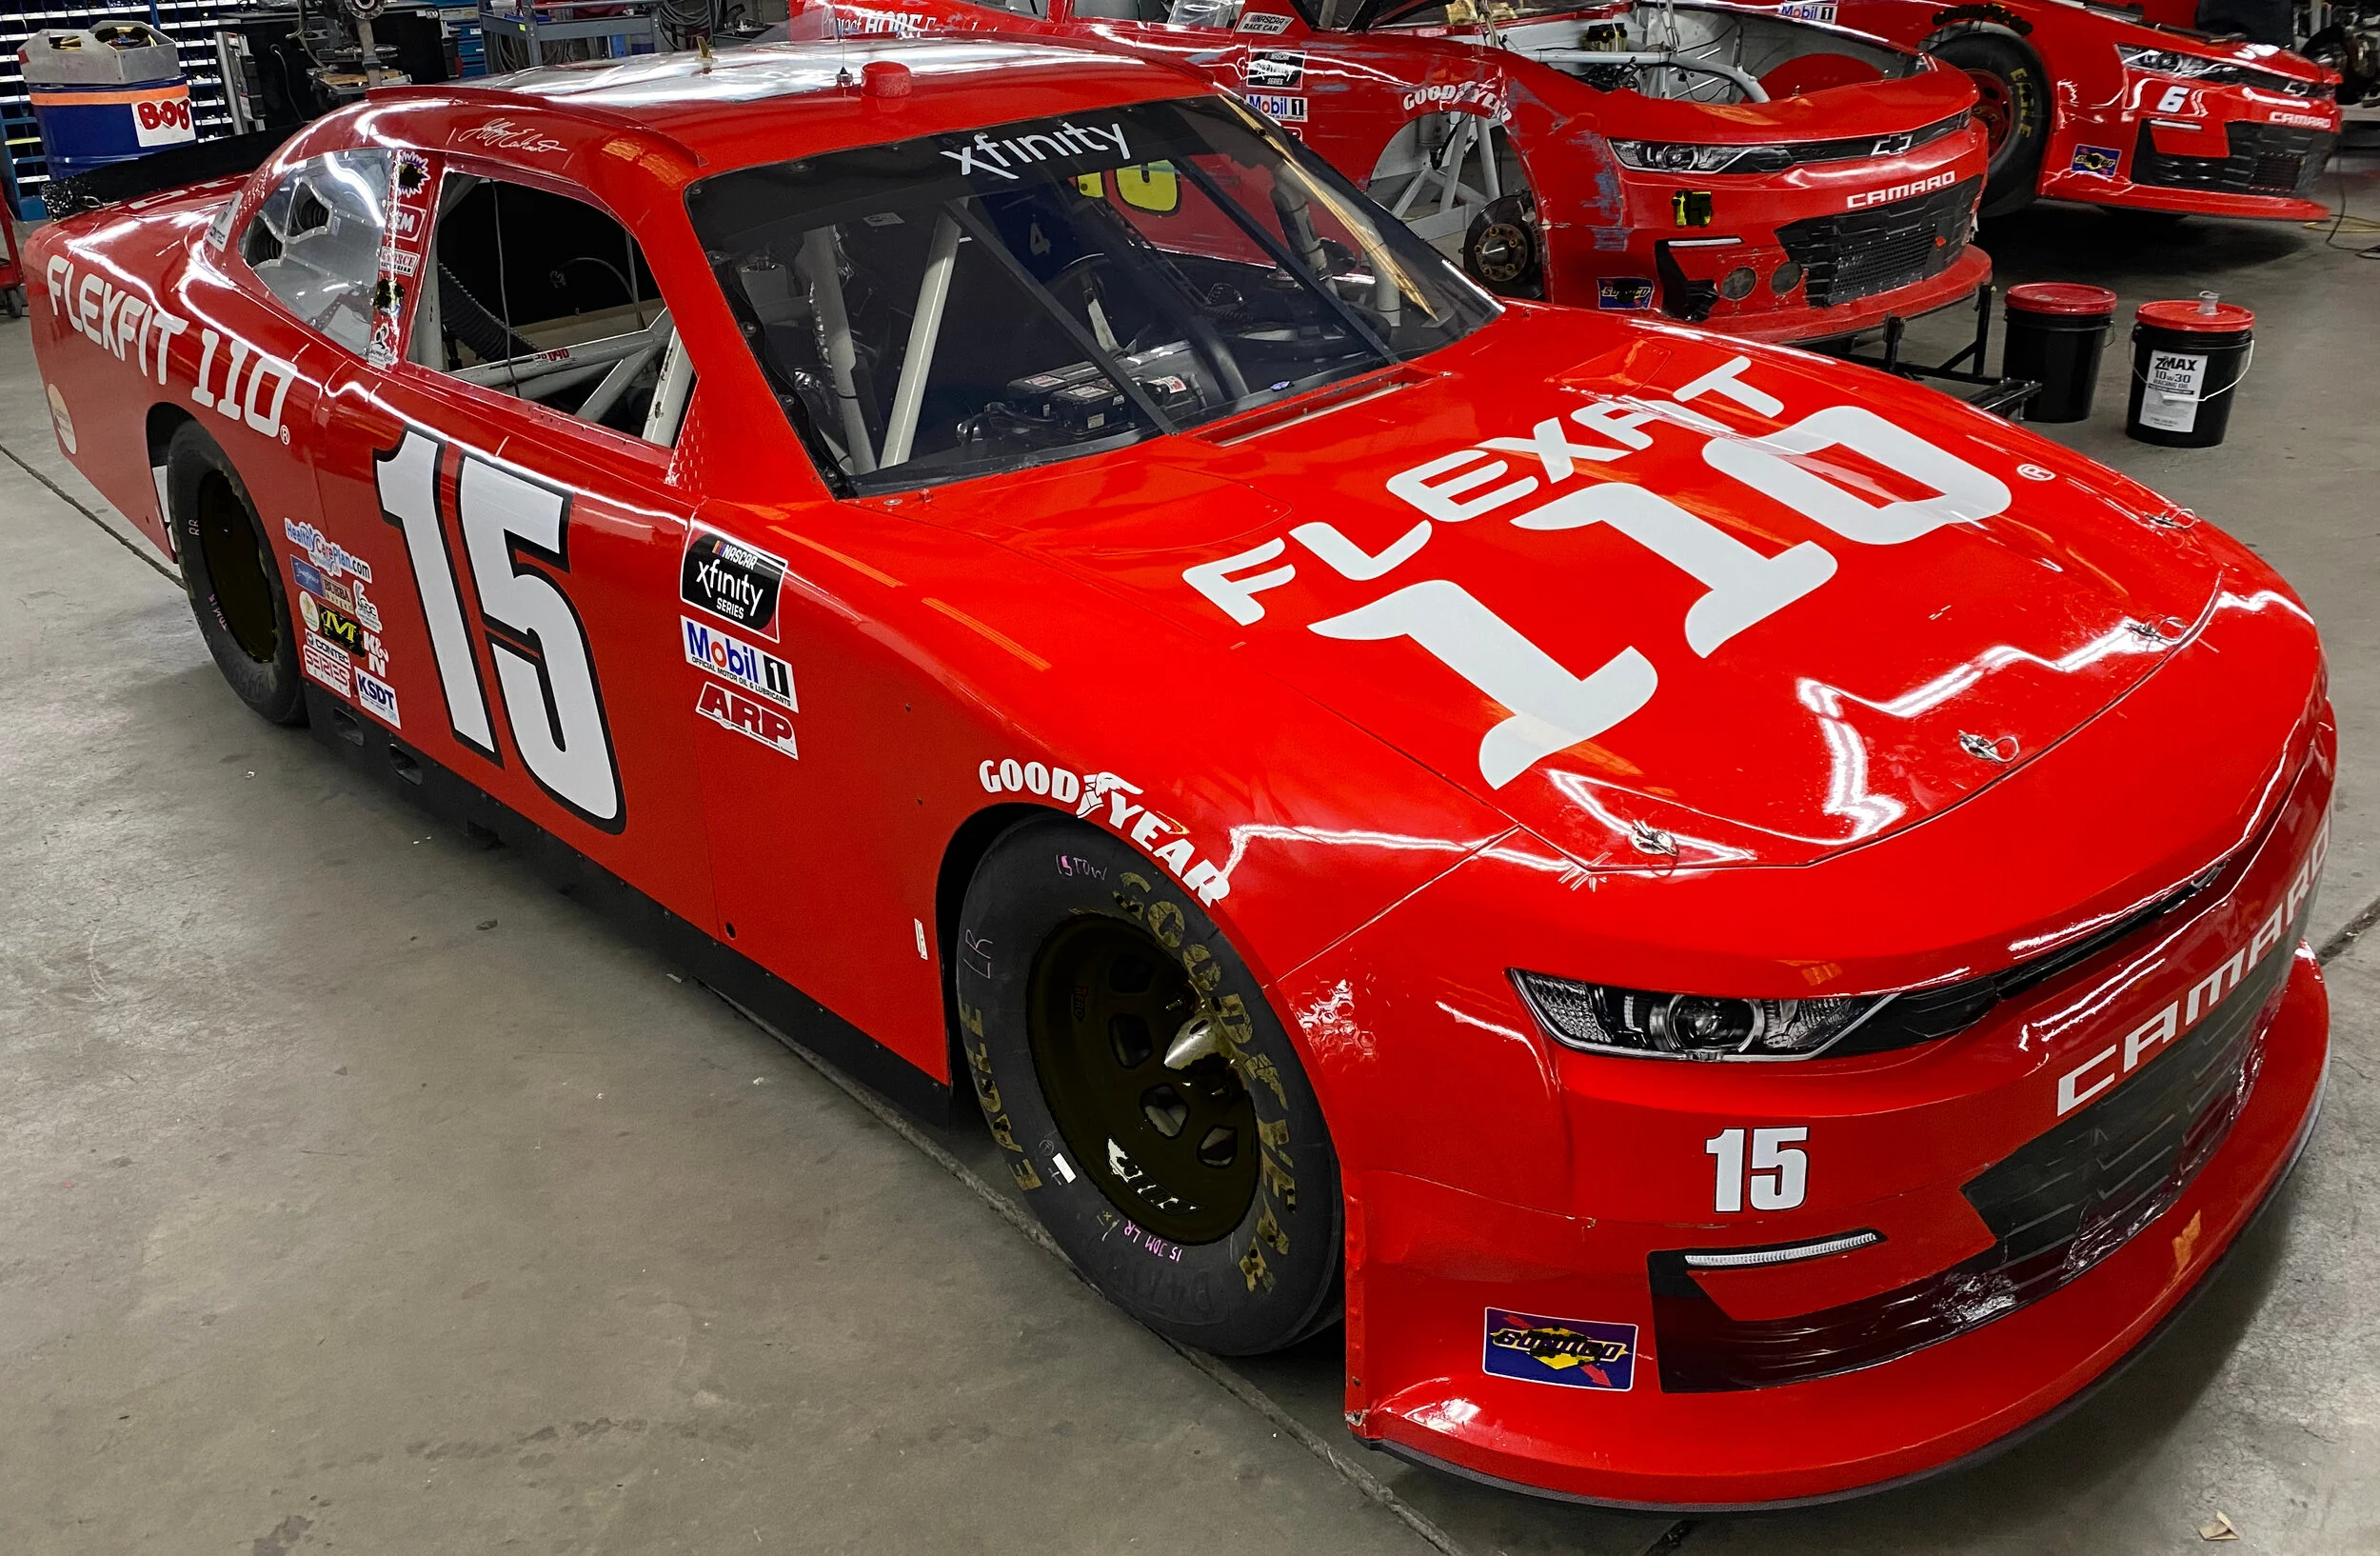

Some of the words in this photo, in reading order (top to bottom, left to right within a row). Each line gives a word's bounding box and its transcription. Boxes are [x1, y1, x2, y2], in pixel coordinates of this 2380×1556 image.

[1252, 15, 1285, 25] NASCAR
[1781, 5, 1818, 19] Mobil
[137, 99, 191, 130] BOB
[1249, 95, 1287, 115] Mobil
[2157, 85, 2190, 113] 6
[2269, 111, 2332, 129] CAMARO
[940, 122, 1131, 180] xfinity
[1847, 170, 1956, 209] CAMARO
[47, 254, 188, 386] FLEXFIT
[191, 330, 297, 438] 110
[2154, 356, 2198, 371] ZMAX
[722, 543, 758, 570] NASCAR
[696, 559, 764, 617] xfinity
[716, 596, 744, 620] SERIES
[1307, 406, 2012, 789] 110
[374, 425, 625, 833] 15
[686, 621, 759, 684] Mobil
[357, 672, 395, 710] KSDT
[691, 655, 716, 673] OFFICIAL
[717, 668, 738, 683] MOTOR
[739, 677, 748, 688] OIL
[755, 685, 792, 708] LUBRICANTS
[699, 684, 793, 744] ARP
[979, 758, 1231, 908] GOODYEAR
[2057, 817, 2329, 1117] CAMARO
[1705, 1127, 1808, 1213] 15
